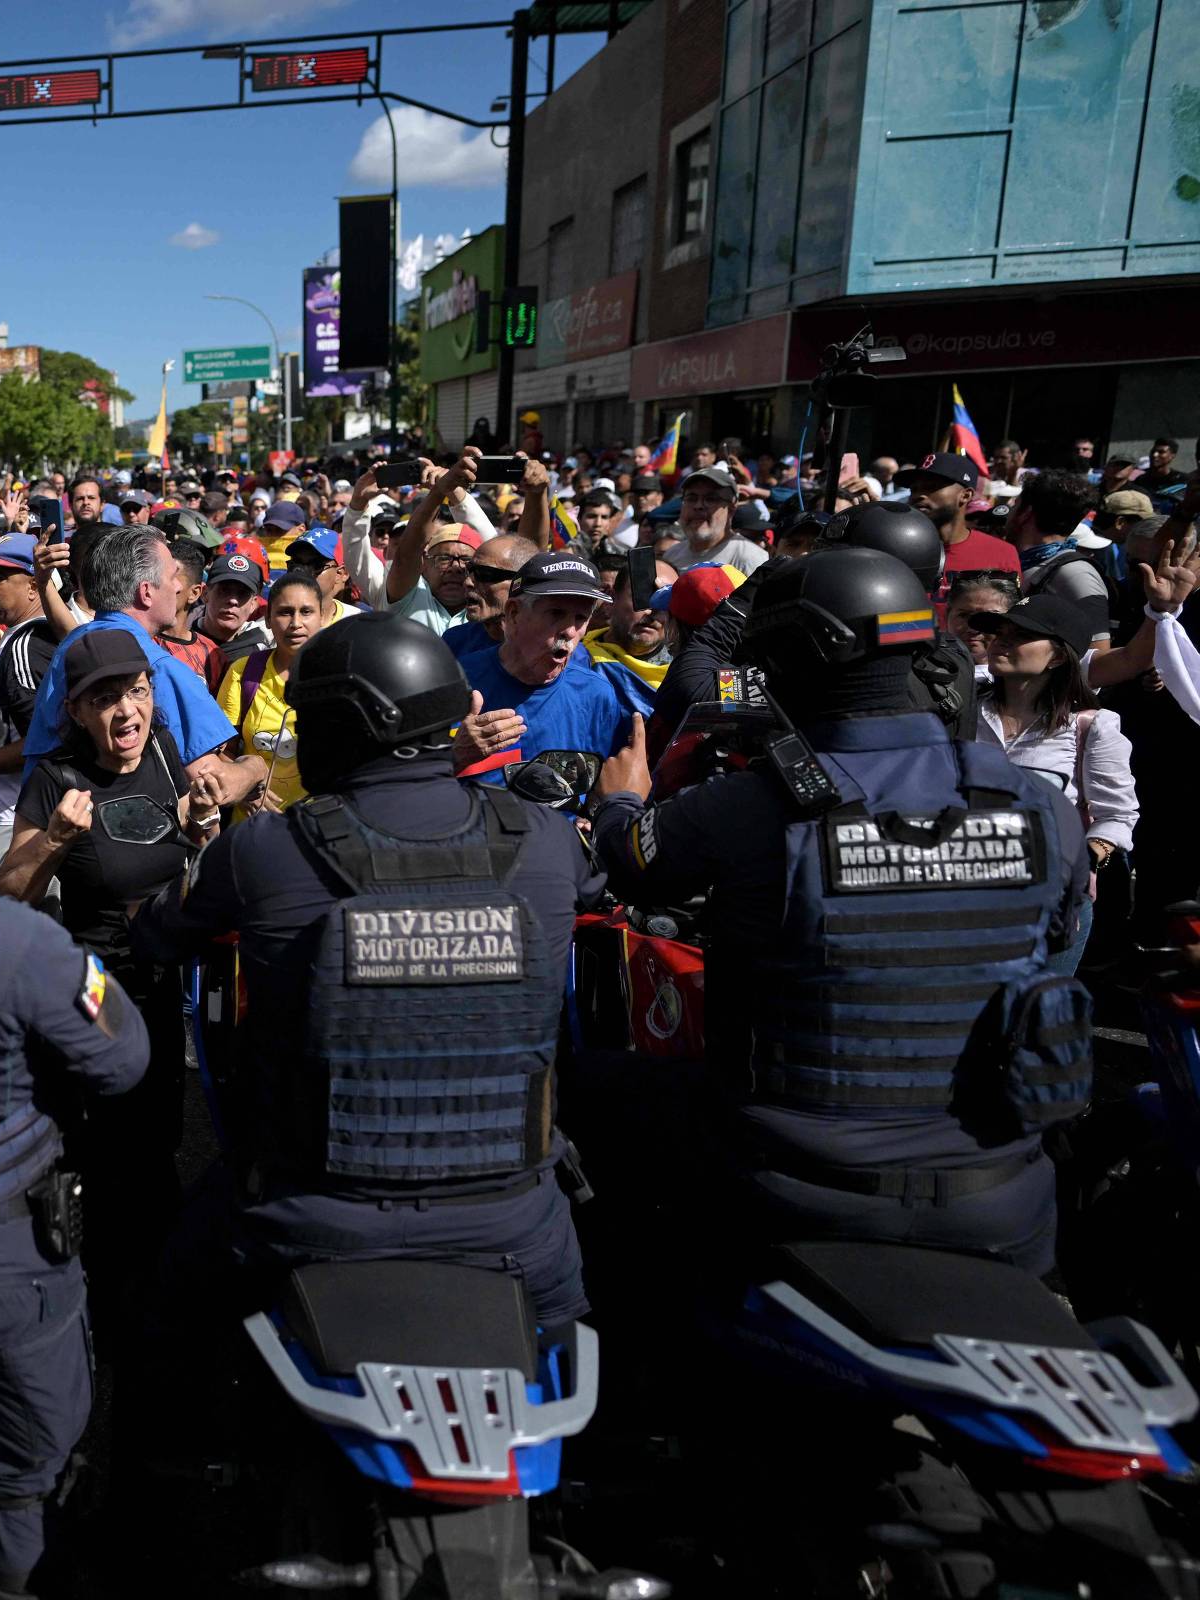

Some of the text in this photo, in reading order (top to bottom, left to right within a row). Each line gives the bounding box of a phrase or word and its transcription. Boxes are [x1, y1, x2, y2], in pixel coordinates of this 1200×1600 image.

[541, 560, 596, 579] VENEZUELA
[641, 807, 657, 864] CPNB
[841, 866, 901, 884] UNIDAD
[903, 865, 923, 882] DE
[924, 864, 943, 881] LA
[353, 906, 518, 936] DIVISION
[354, 934, 517, 962] MOTORIZADA
[357, 960, 517, 978] UNIDAD DE LA PRECISION
